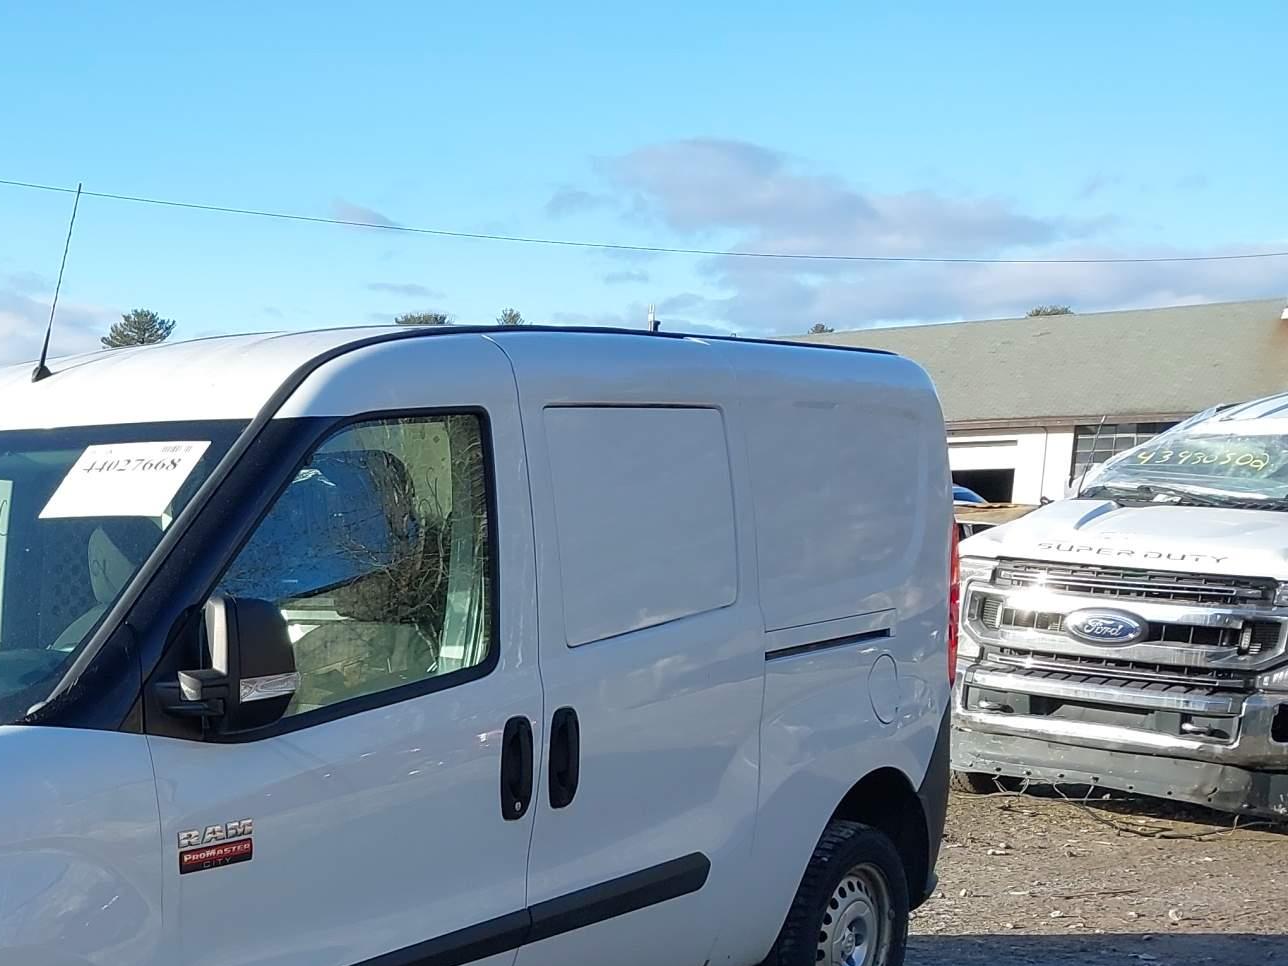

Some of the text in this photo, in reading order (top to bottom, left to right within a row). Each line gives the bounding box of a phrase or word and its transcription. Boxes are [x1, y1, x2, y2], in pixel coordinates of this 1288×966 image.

[83, 458, 182, 474] 44027668
[1137, 450, 1270, 471] 43930502
[1038, 543, 1228, 564] SUPER DUTY
[1083, 617, 1123, 637] Ford
[177, 818, 253, 849] RAM
[203, 857, 232, 868] CITY
